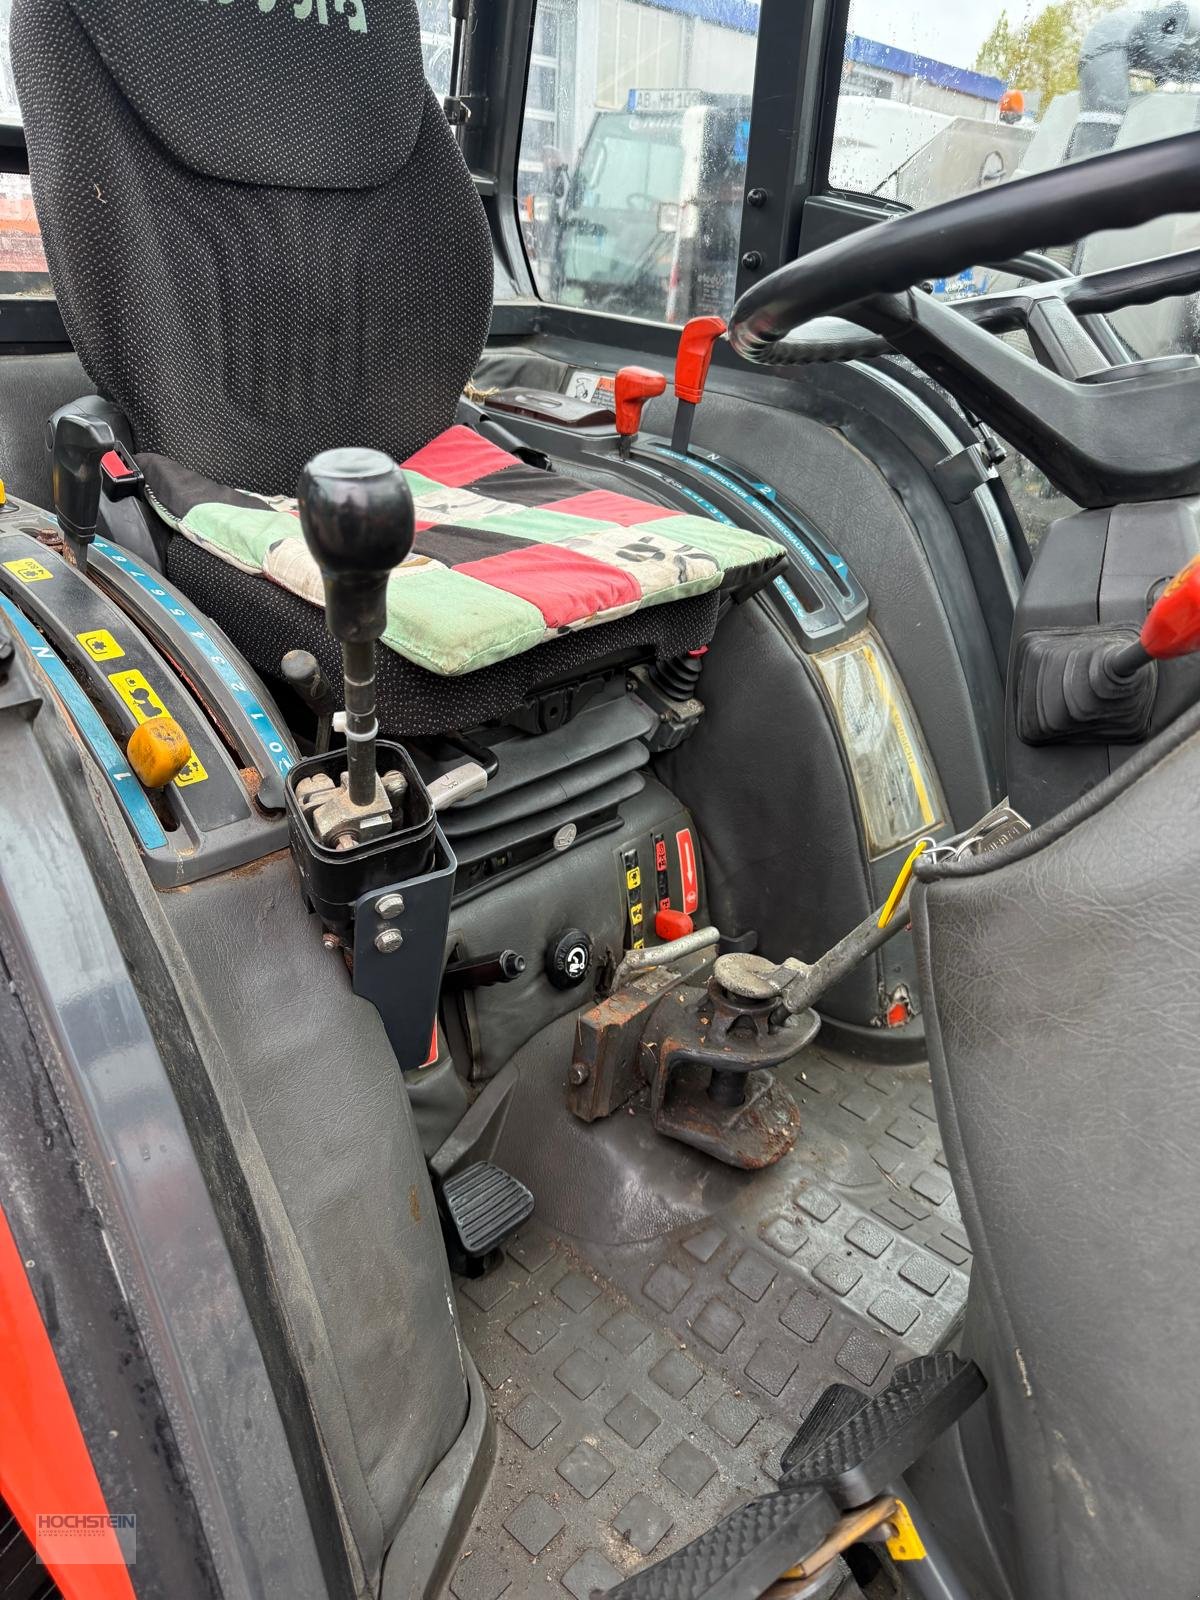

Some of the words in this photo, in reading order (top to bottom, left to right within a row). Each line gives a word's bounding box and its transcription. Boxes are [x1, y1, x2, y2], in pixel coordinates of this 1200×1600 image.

[706, 452, 721, 461] N
[759, 486, 772, 495] 2
[836, 561, 845, 569] 1
[31, 646, 56, 658] N
[169, 608, 185, 616] 5
[190, 630, 206, 639] 4
[210, 655, 226, 665] 3
[230, 682, 248, 692] 2
